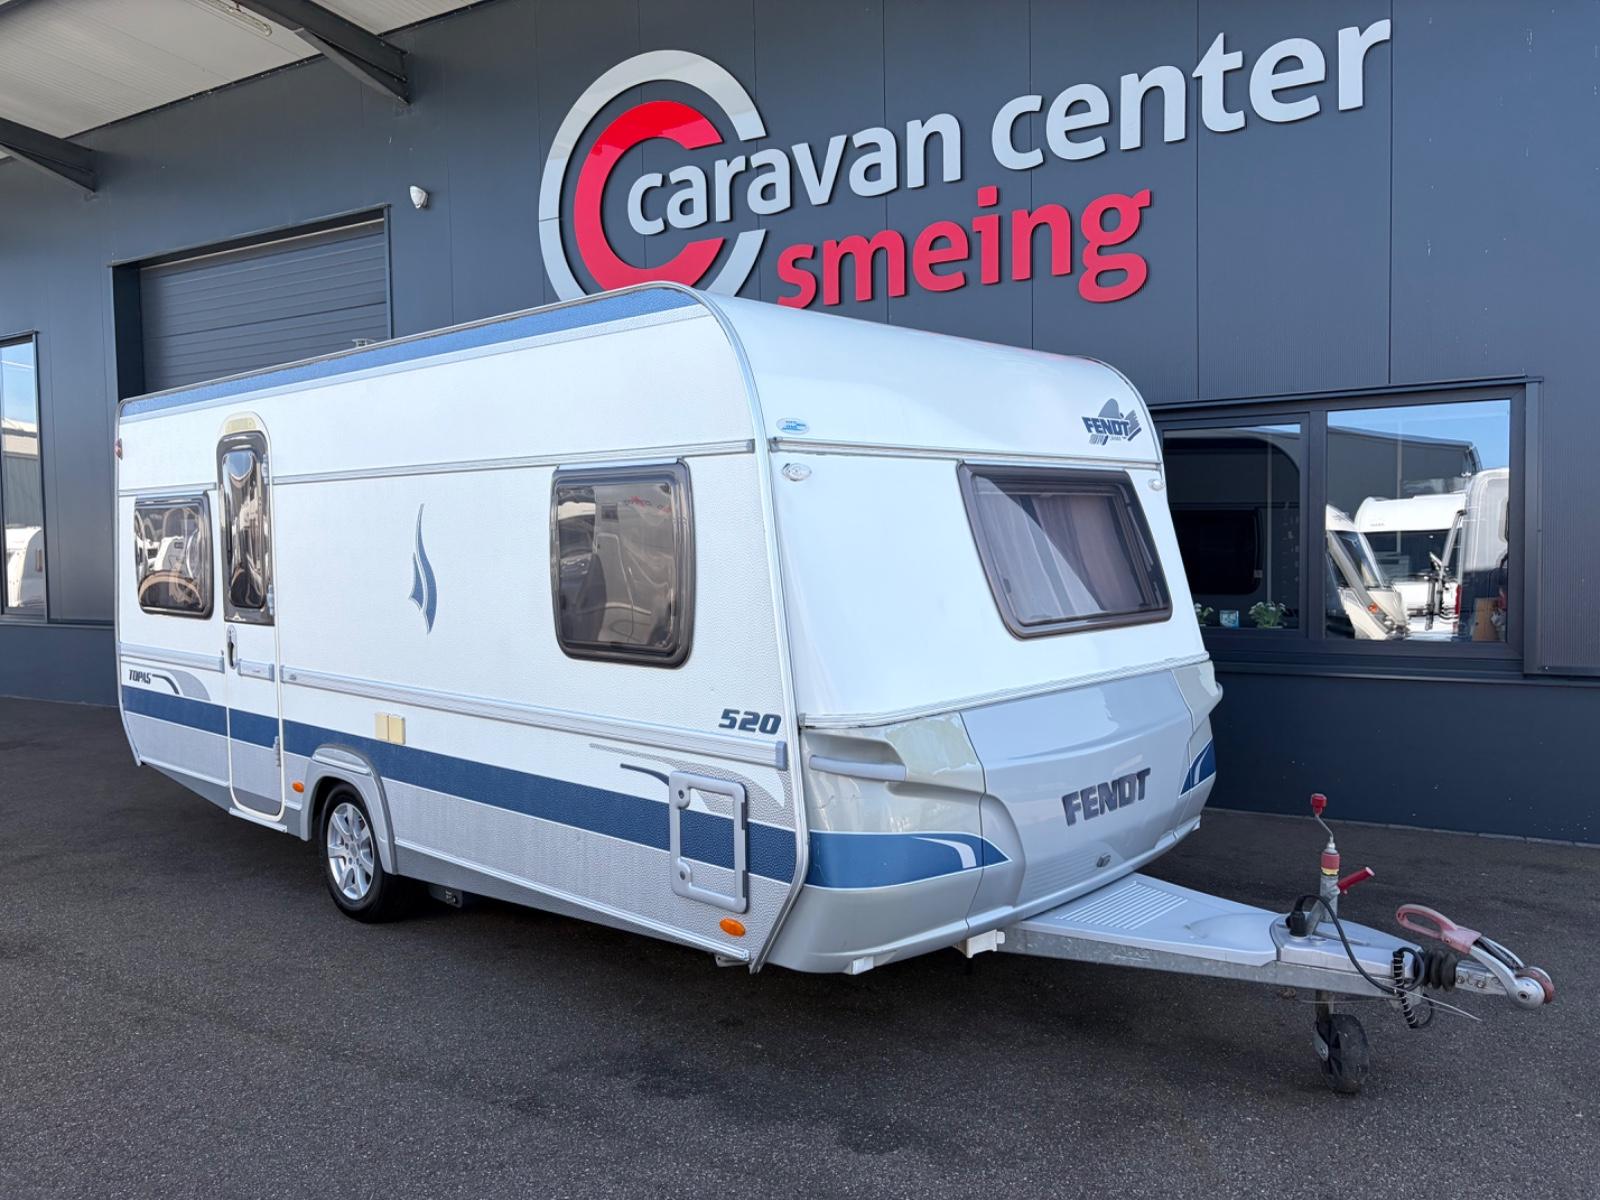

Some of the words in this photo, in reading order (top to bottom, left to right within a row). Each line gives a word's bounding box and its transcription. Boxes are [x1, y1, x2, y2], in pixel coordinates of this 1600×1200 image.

[626, 112, 963, 236] caravan
[991, 19, 1392, 170] center
[776, 186, 1152, 308] smeing
[1081, 416, 1130, 437] FENDT
[128, 669, 151, 684] TOPAS
[718, 708, 782, 735] 520
[1061, 767, 1152, 827] FENDT
